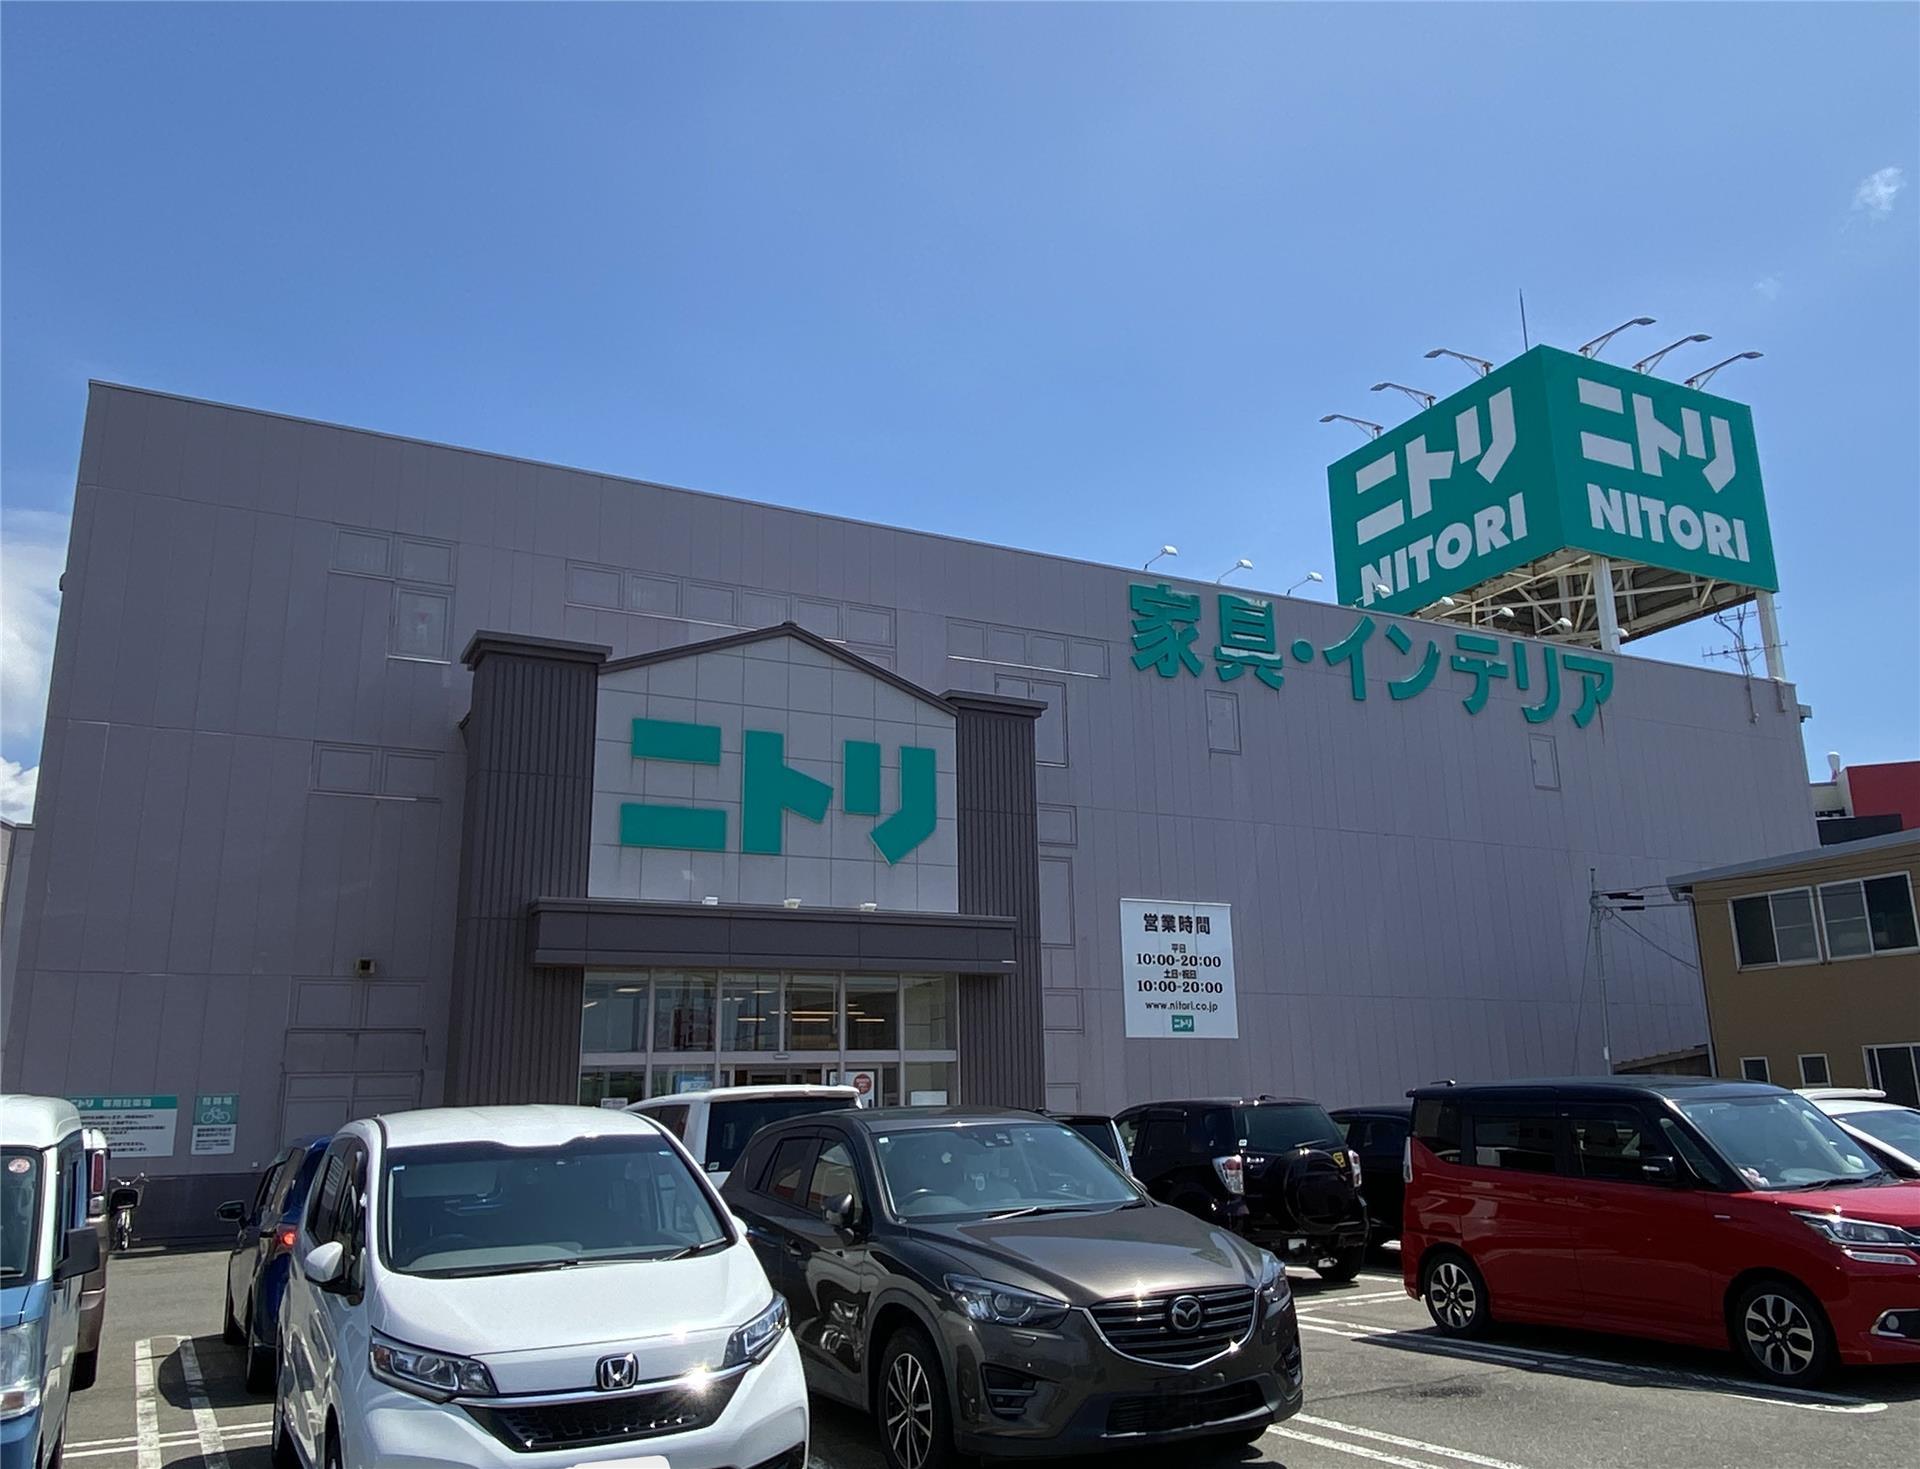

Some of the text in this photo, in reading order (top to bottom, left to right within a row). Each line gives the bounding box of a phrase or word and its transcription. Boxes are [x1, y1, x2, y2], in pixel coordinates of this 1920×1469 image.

[1578, 377, 1736, 494] ニトリ
[1356, 387, 1516, 545] ニトリ
[1587, 483, 1750, 563] NITORI
[1360, 492, 1528, 607] NITORI
[1129, 580, 1615, 730] 家具・インテリア
[620, 718, 937, 866] ニトリ
[1143, 913, 1211, 935] 営業時間
[1171, 943, 1186, 954] 平日
[1136, 953, 1222, 968] 10:00-20:00
[1137, 980, 1223, 994] 10:00-20:00
[1145, 1001, 1218, 1013] www.nitori.co.jp
[1174, 1018, 1192, 1029] ニトリ
